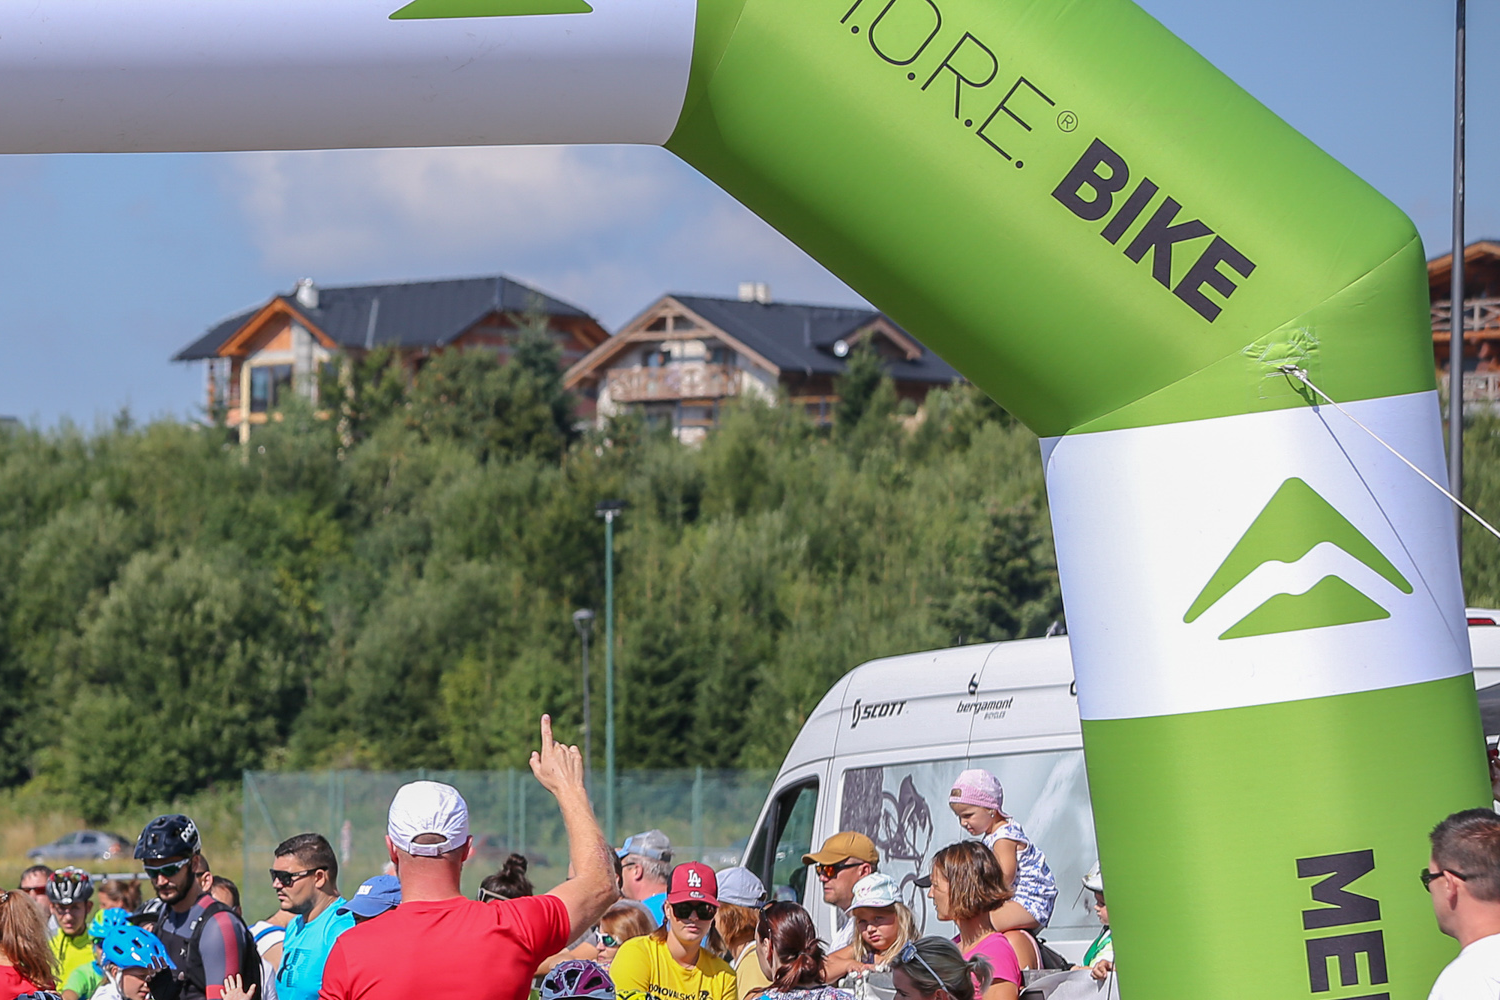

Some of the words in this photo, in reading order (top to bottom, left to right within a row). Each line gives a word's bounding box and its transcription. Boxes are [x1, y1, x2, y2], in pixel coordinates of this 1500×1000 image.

[1051, 138, 1257, 323] BIKE
[860, 701, 907, 720] SCOTT
[956, 697, 1014, 715] bergamont
